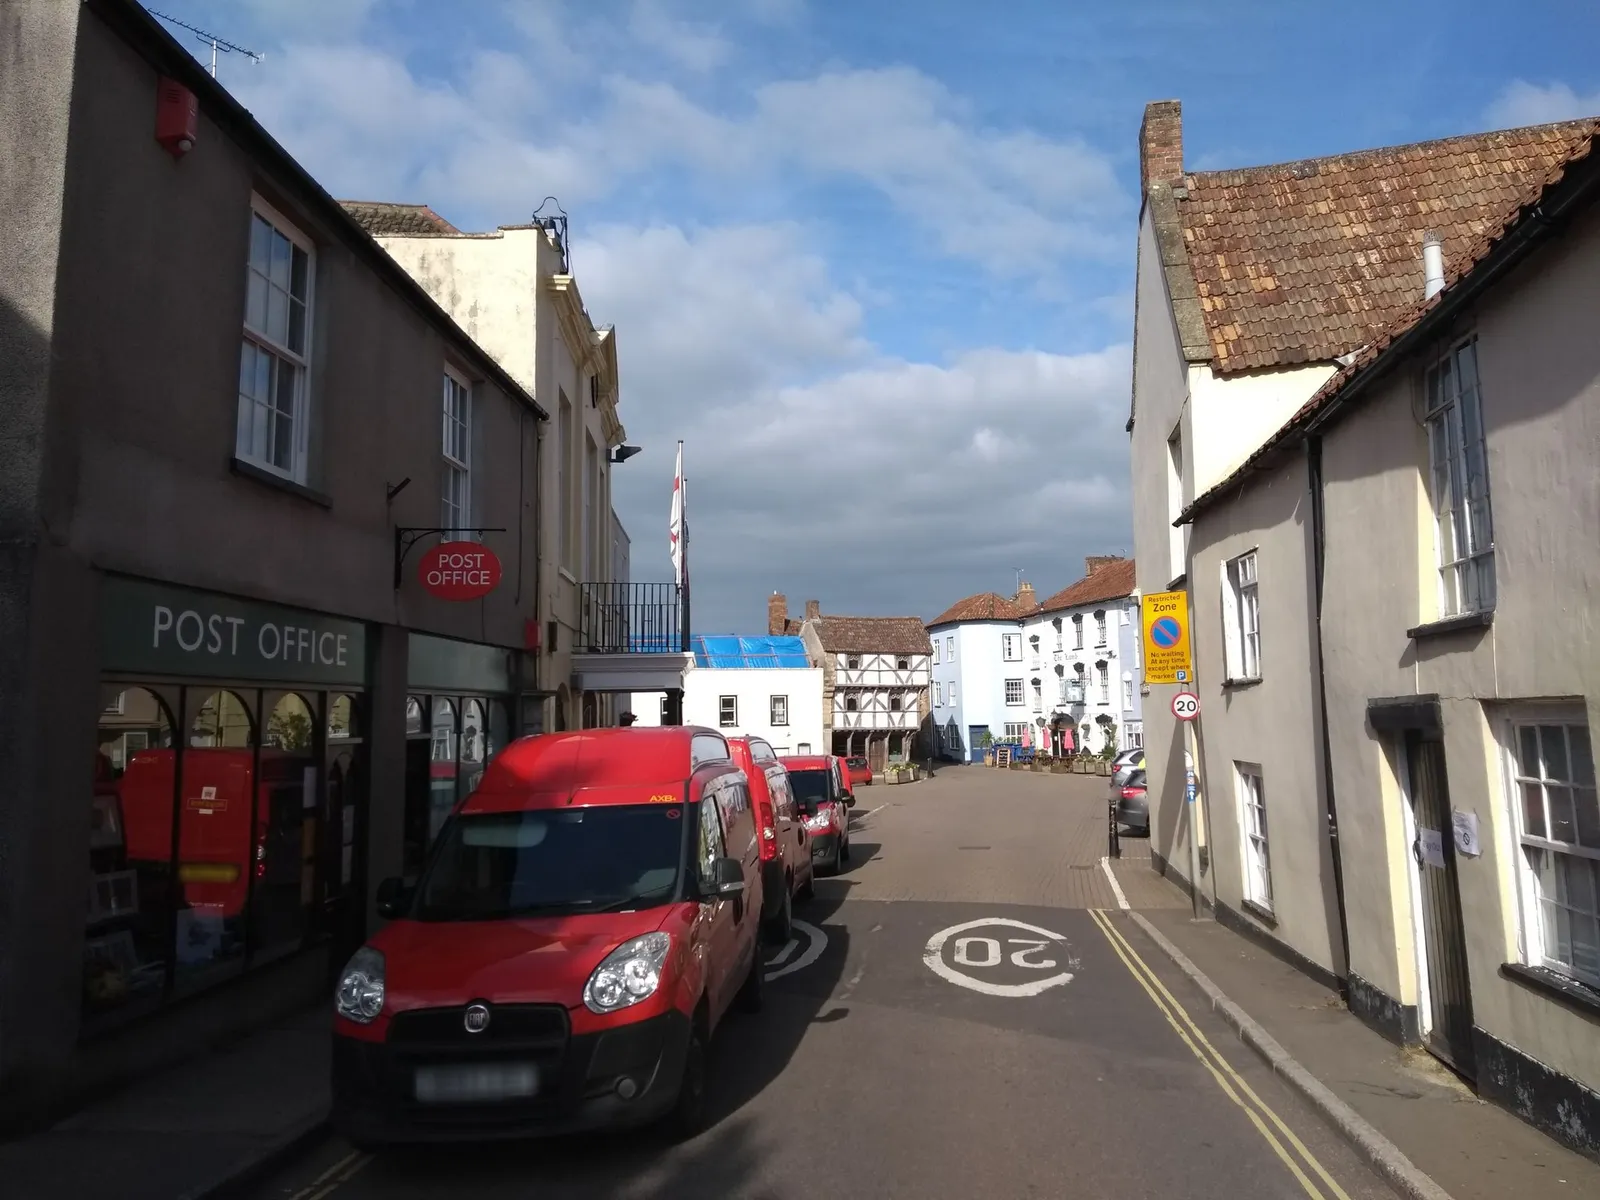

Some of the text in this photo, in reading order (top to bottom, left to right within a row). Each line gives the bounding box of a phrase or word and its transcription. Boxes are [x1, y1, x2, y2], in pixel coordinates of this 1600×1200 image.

[438, 553, 485, 568] POST
[427, 570, 491, 586] OFFICE
[1148, 595, 1180, 603] Restricted
[1153, 603, 1177, 612] Zone
[153, 605, 348, 667] POST OFFICE
[1176, 700, 1197, 712] 20
[954, 937, 1056, 968] 20
[469, 1012, 485, 1025] FIAT
